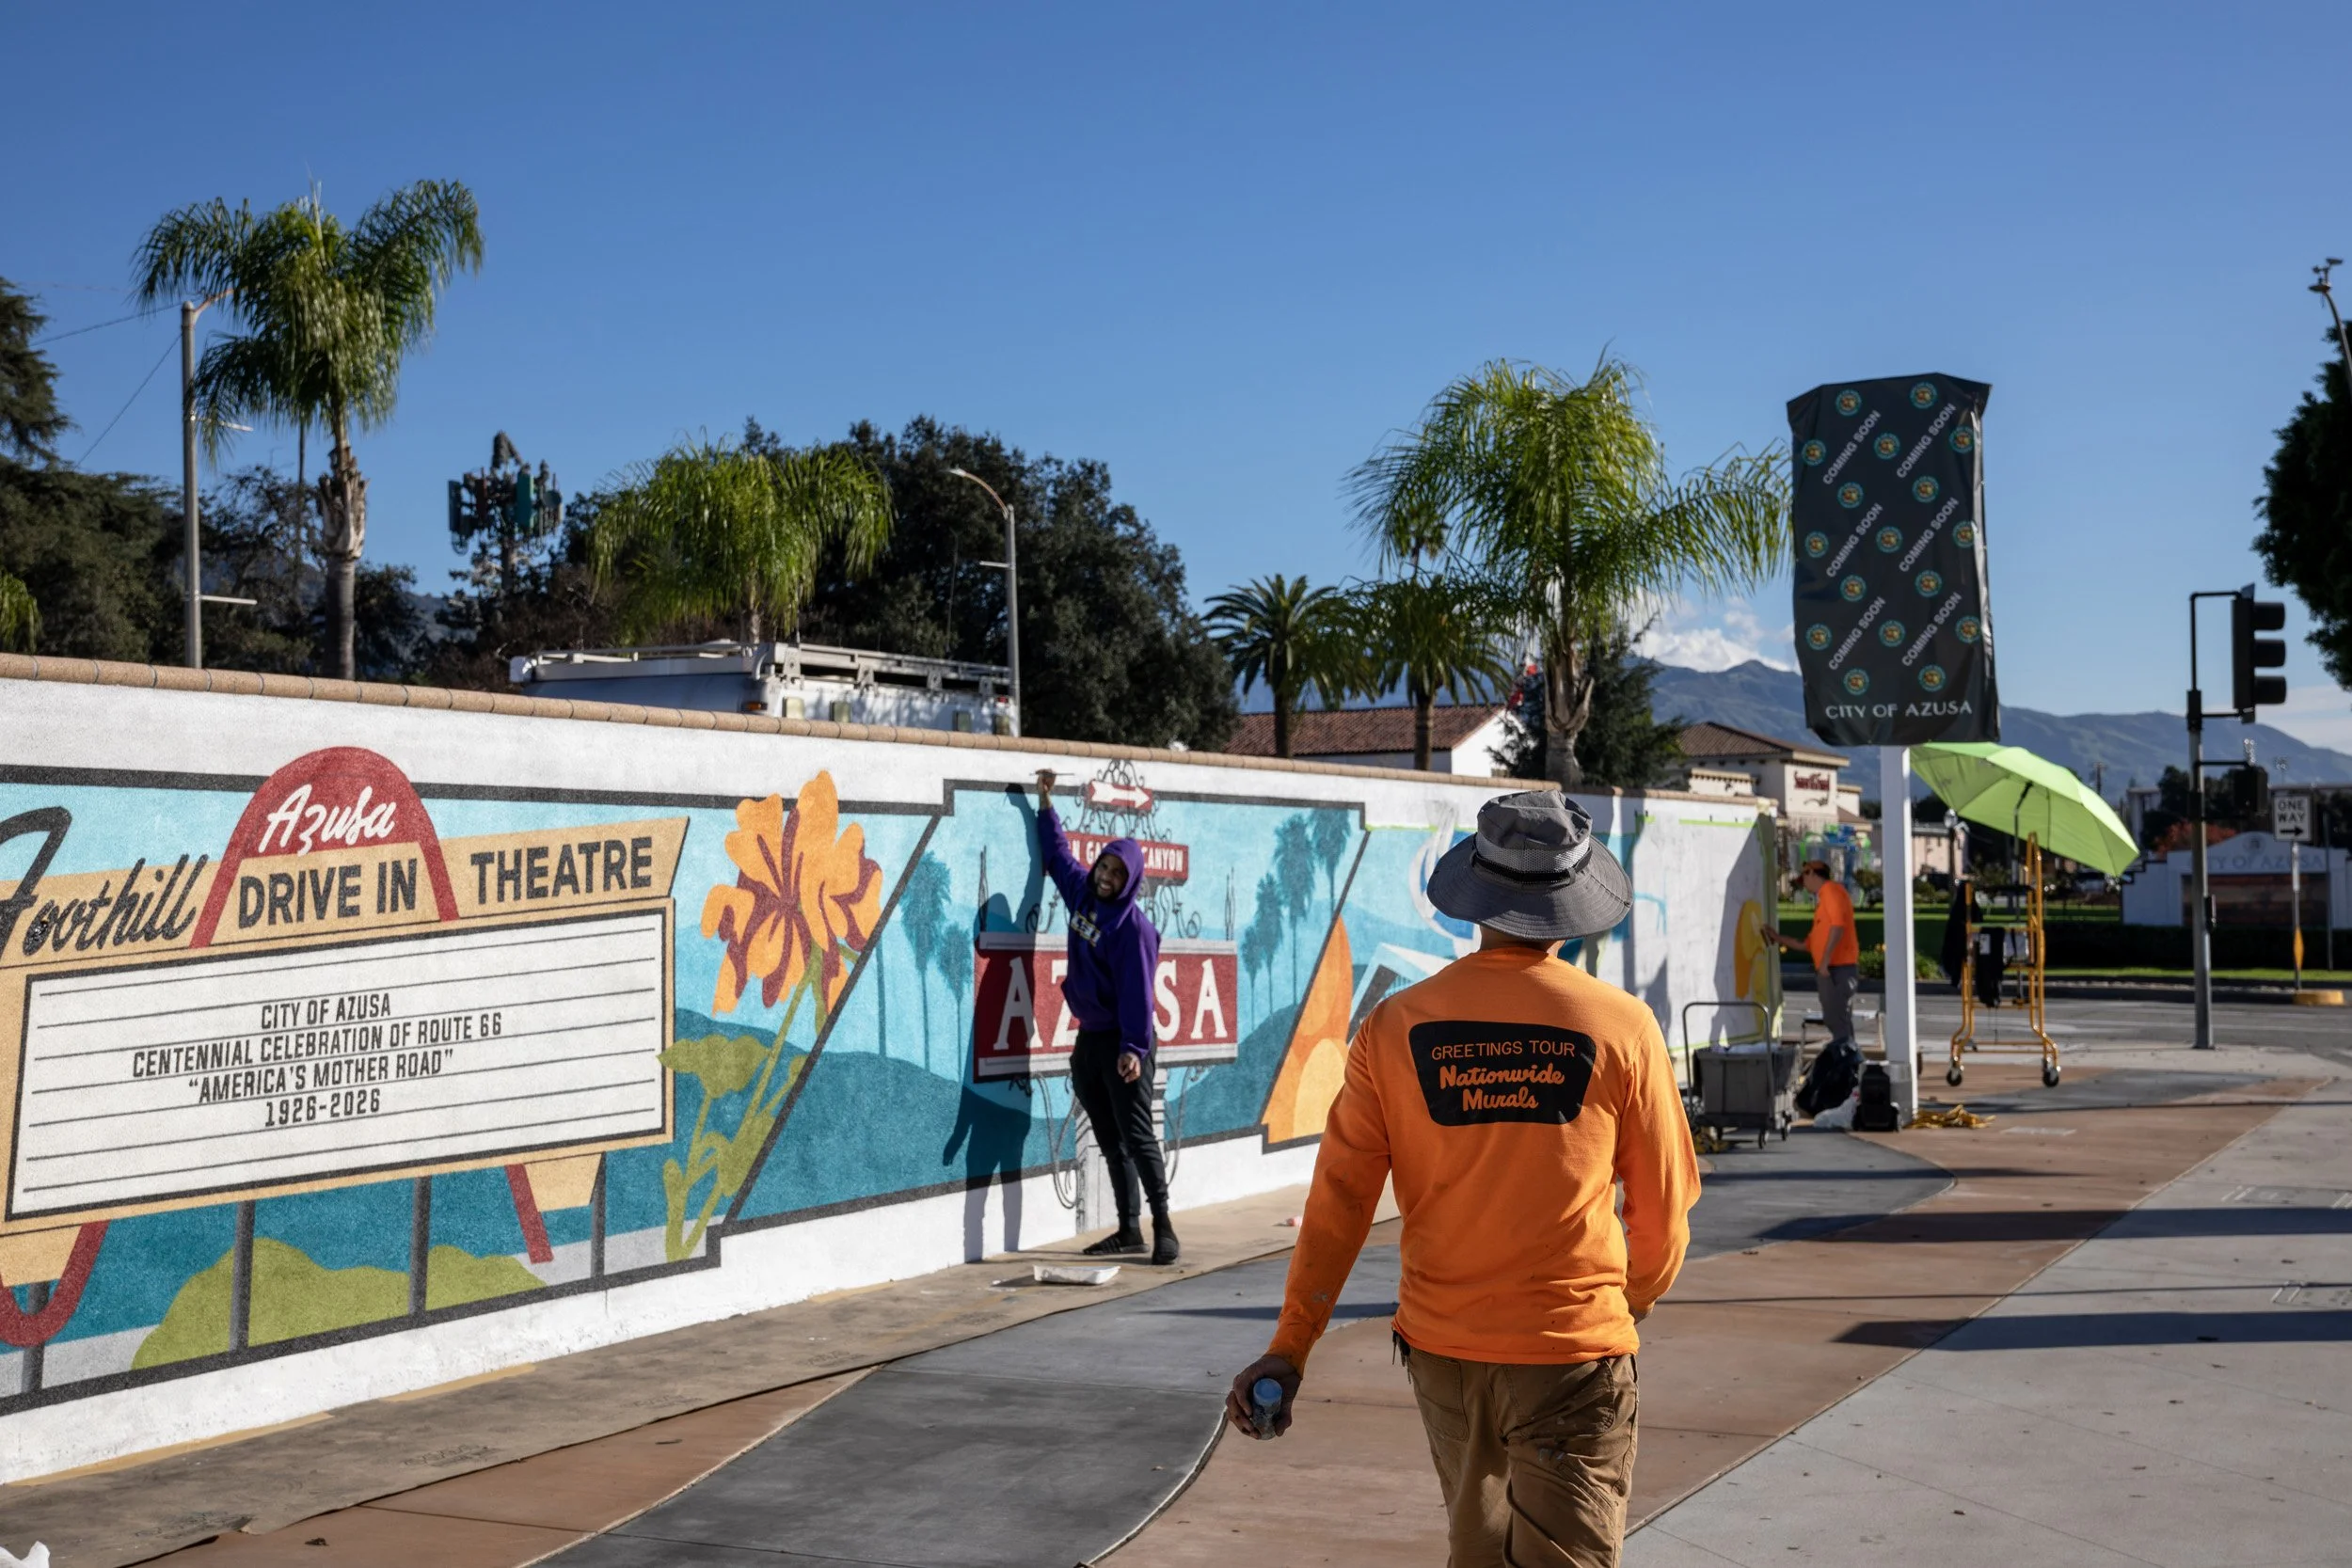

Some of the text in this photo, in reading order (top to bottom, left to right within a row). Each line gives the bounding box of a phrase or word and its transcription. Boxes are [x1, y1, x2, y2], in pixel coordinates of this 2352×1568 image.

[1823, 441, 1858, 484] COMING
[1853, 409, 1882, 443] SOON
[1897, 435, 1932, 478] COMING
[1928, 403, 1956, 436] SOON
[1826, 534, 1859, 578] COMING
[1855, 502, 1883, 536] SOON
[1899, 529, 1934, 572] COMING
[1931, 497, 1959, 530] SOON
[1828, 627, 1863, 670] COMING
[1858, 596, 1886, 629] SOON
[1901, 623, 1938, 666] COMING
[1934, 592, 1963, 625] SOON
[1825, 700, 1973, 720] CITY OF AZUSA
[258, 784, 397, 857] Azusa
[2278, 800, 2305, 810] ONE
[2278, 812, 2305, 823] WAY
[238, 864, 361, 929] DRIVE
[376, 858, 417, 914] IN
[470, 836, 652, 905] THEATRE
[2261, 854, 2324, 868] AZSA
[261, 993, 391, 1030] CITY OF AZUSA
[993, 956, 1228, 1051] AZSA
[133, 1012, 501, 1078] CENTENNIAL CELEBRATION OF ROUTE 66
[1431, 1039, 1575, 1061] GREETINGS TOUR
[188, 1049, 453, 1103] "AMERICA'S MOTHER ROAD"
[1439, 1063, 1565, 1089] Nationwide
[1462, 1085, 1539, 1112] Murals
[265, 1088, 380, 1127] 1926-2026
